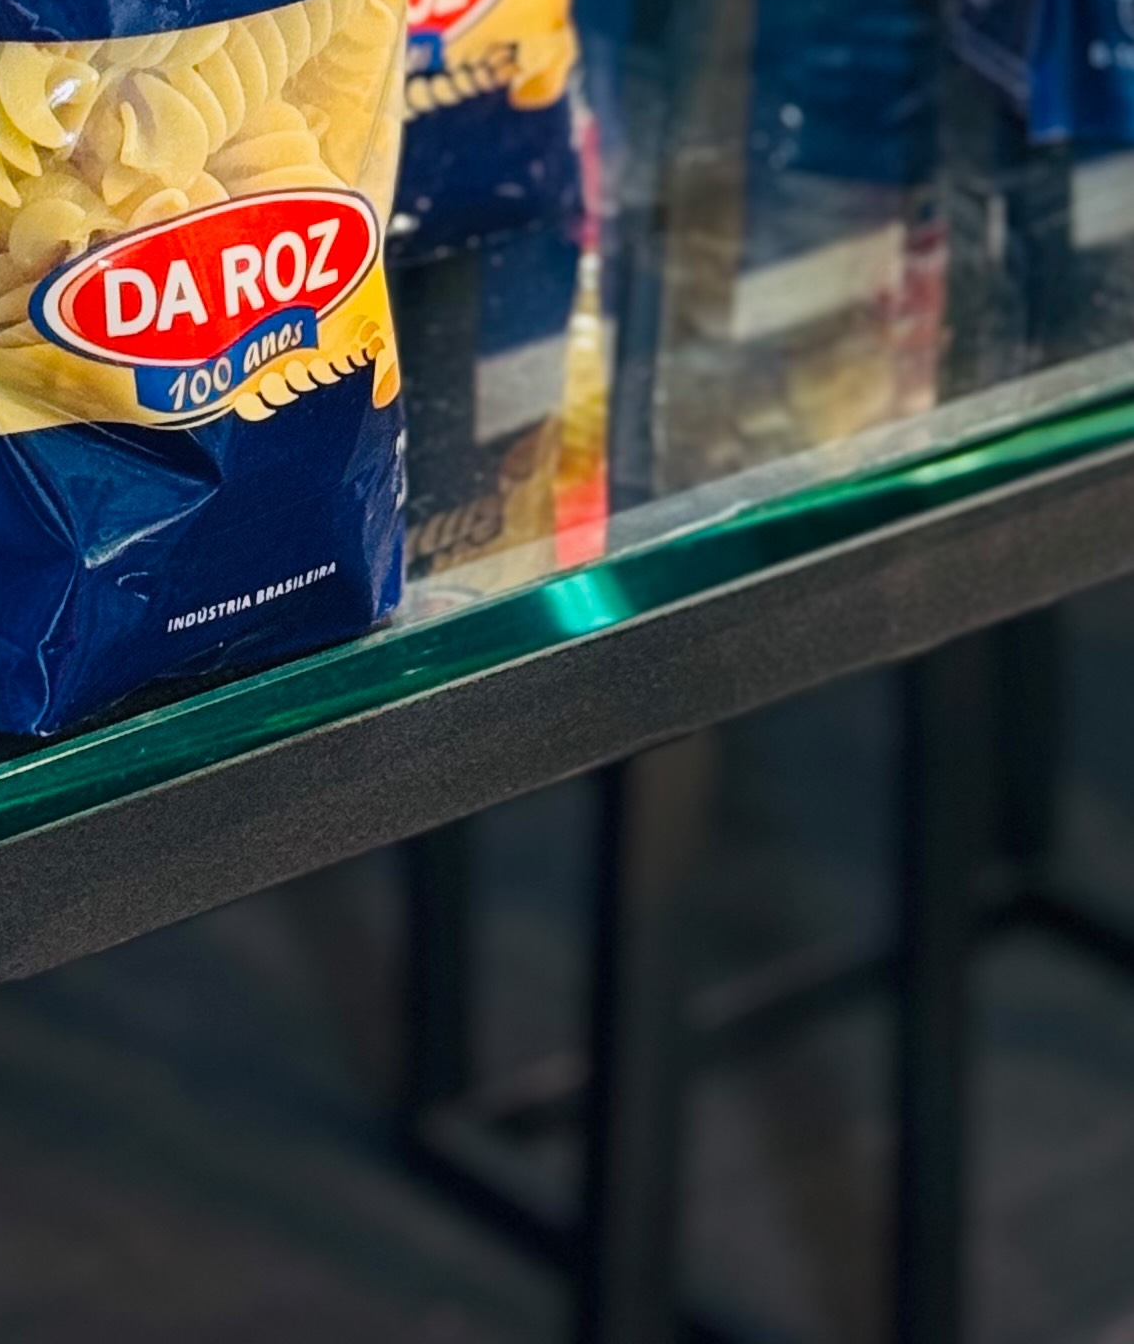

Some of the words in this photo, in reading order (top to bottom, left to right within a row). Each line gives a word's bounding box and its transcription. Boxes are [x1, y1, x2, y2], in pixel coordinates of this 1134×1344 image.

[103, 259, 209, 338] DA
[221, 217, 341, 318] ROZ
[168, 356, 233, 411] 100
[243, 320, 304, 374] anos
[255, 561, 336, 605] BRASILEIRA
